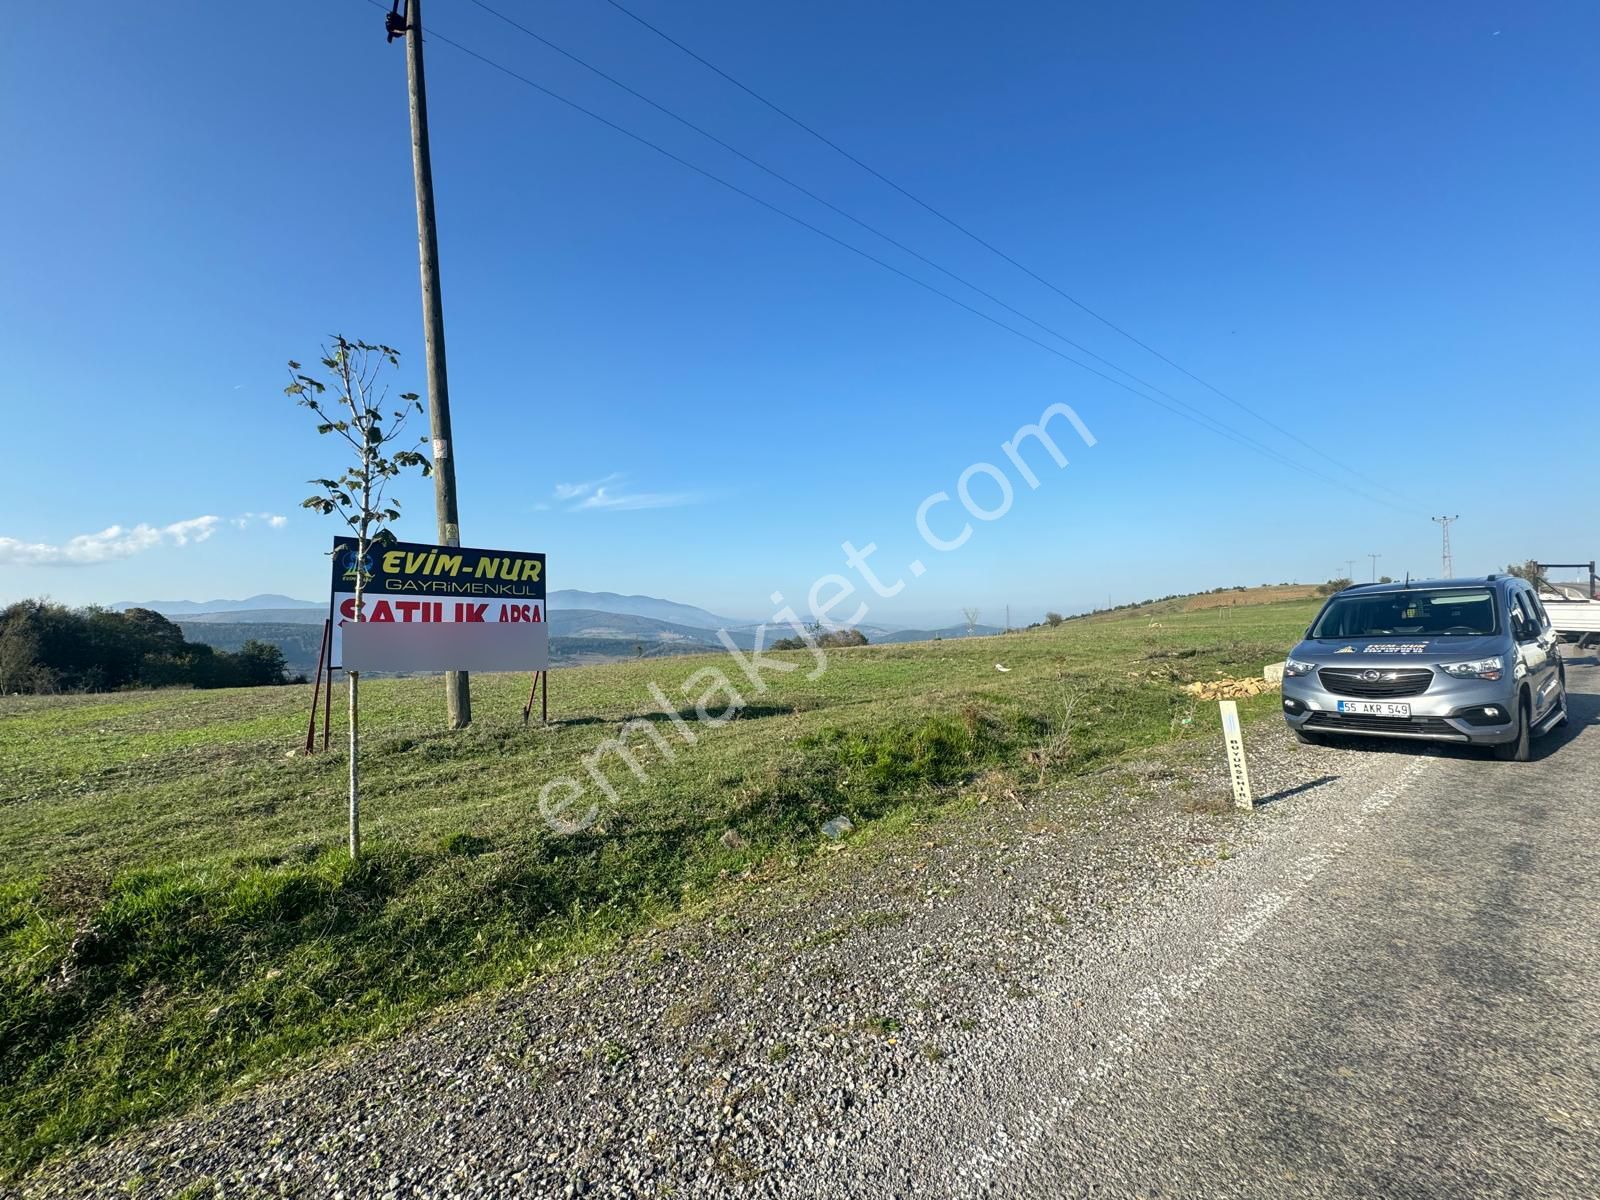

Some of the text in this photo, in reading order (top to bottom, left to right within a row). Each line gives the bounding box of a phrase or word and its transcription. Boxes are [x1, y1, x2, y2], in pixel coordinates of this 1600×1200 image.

[382, 549, 542, 582] EVİM-NUR
[1344, 703, 1408, 715] 55 AKR 549
